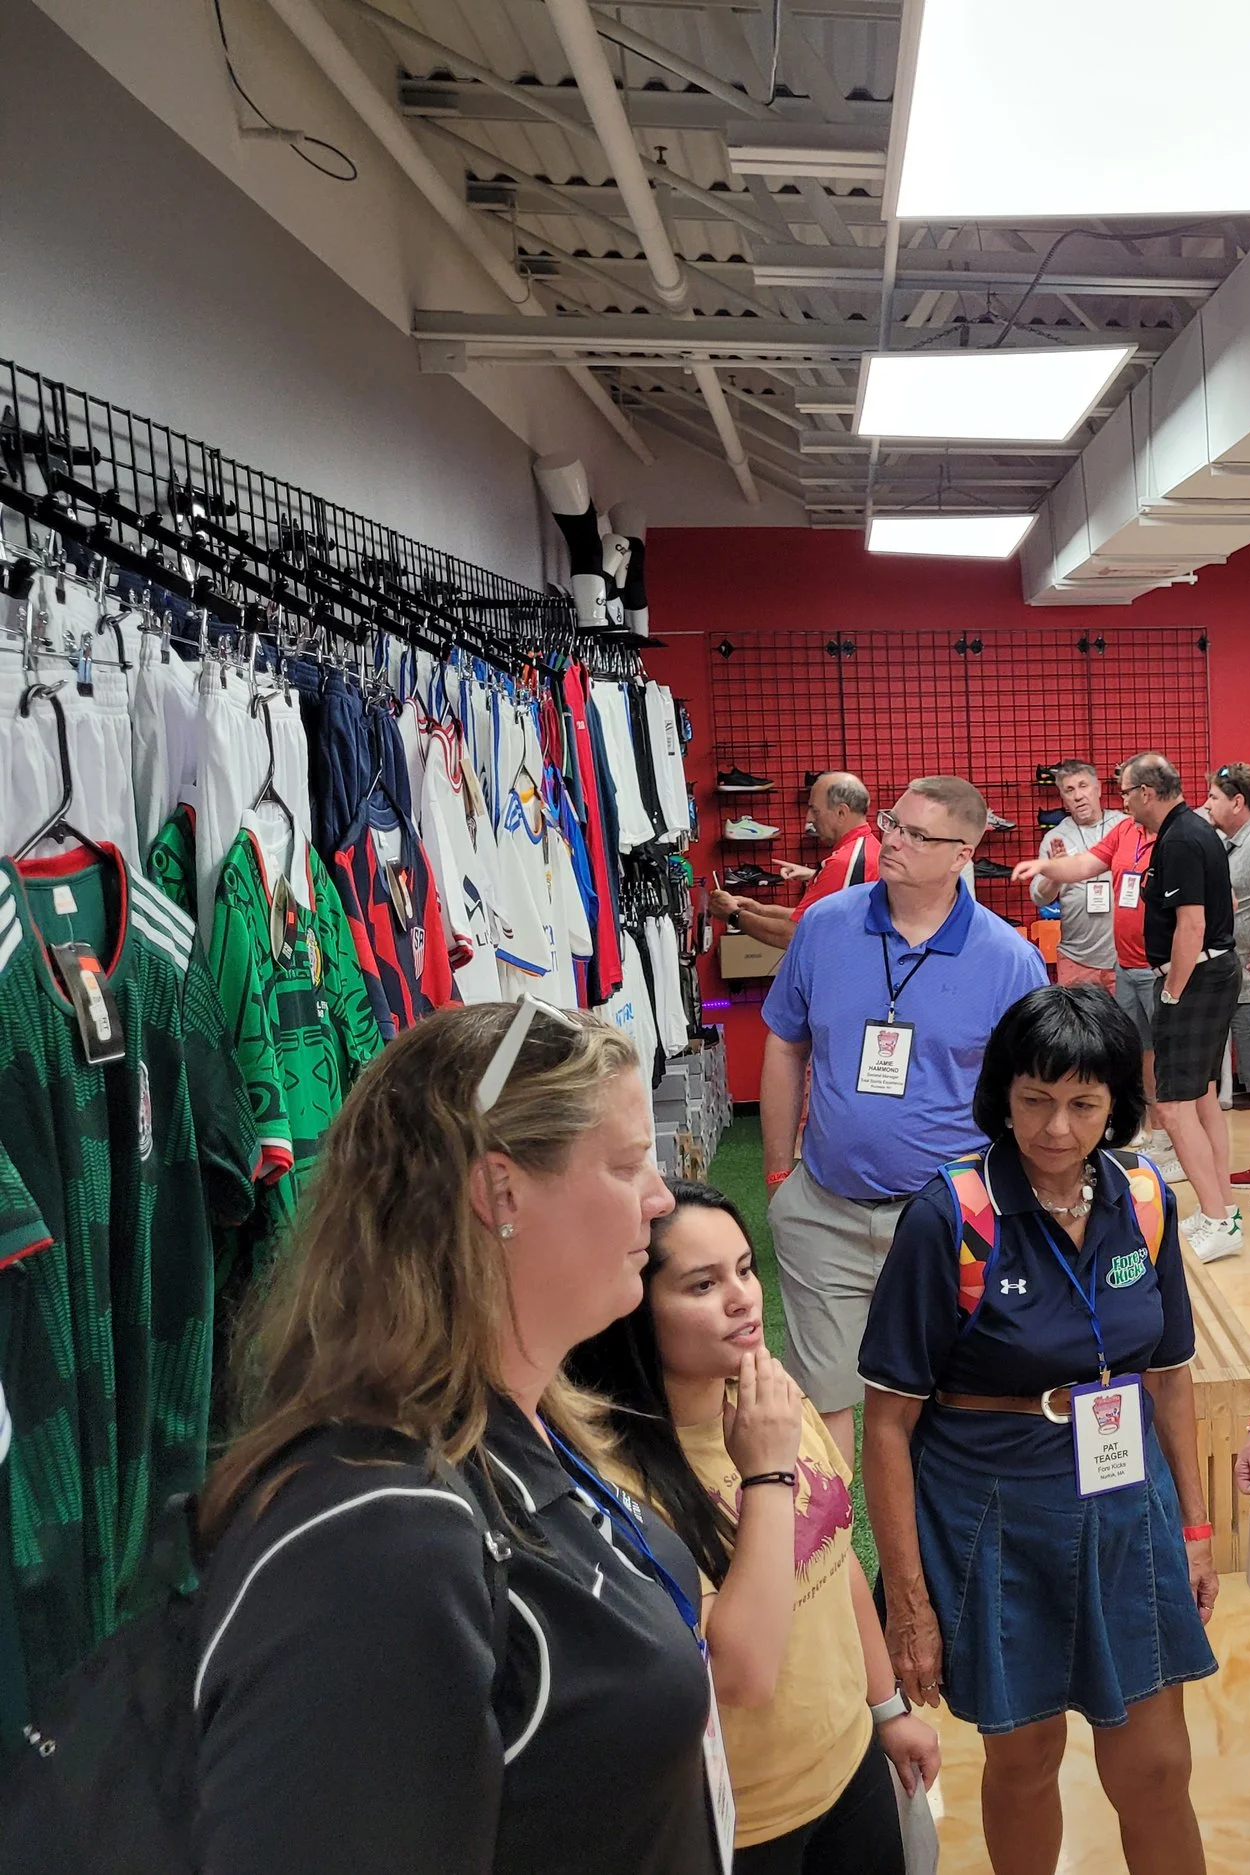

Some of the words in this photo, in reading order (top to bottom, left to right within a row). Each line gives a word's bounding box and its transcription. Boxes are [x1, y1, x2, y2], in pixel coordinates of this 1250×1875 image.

[868, 1066, 900, 1074] HAMMOND
[1113, 1252, 1138, 1271] Fore
[1103, 1441, 1119, 1453] PAT
[1094, 1449, 1129, 1465] TEAGER
